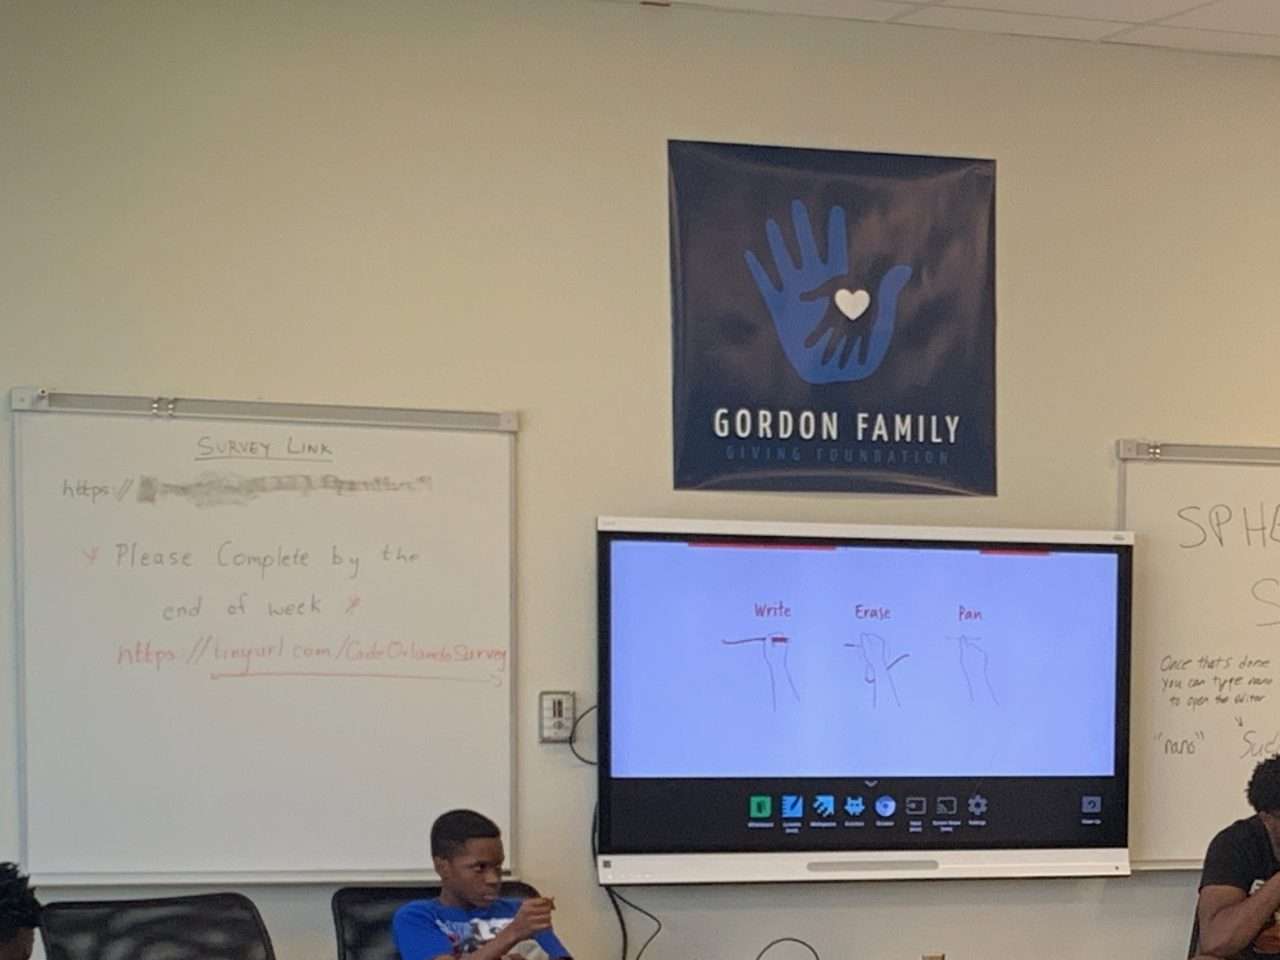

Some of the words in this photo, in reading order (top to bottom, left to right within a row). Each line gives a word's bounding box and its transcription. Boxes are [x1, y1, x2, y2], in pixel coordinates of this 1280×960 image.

[713, 407, 839, 440] GORDON
[857, 412, 961, 443] FAMILY
[197, 437, 271, 459] SURVEY
[286, 434, 334, 456] LINK
[726, 444, 802, 461] GIVING
[816, 446, 950, 465] FOUNDATION
[115, 542, 193, 568] Please
[216, 540, 310, 579] Complete
[331, 543, 361, 578] by
[382, 542, 420, 564] the
[162, 595, 204, 621] end
[227, 594, 247, 616] of
[268, 592, 322, 616] week
[754, 601, 792, 618] Write
[855, 604, 892, 620] Erase
[957, 605, 984, 621] Pan
